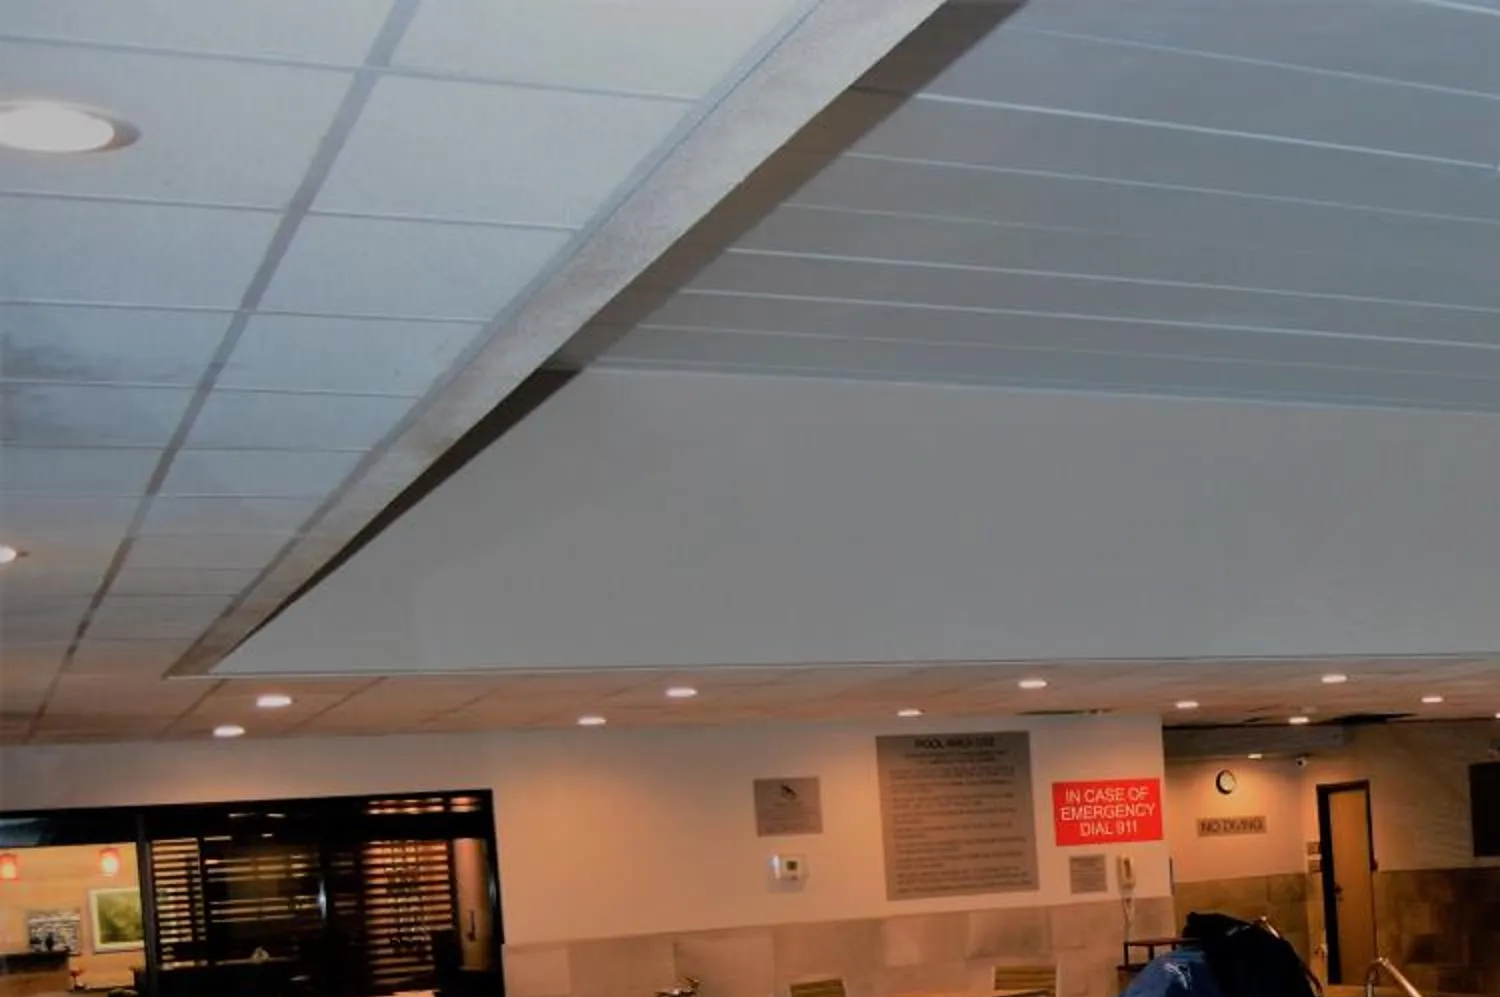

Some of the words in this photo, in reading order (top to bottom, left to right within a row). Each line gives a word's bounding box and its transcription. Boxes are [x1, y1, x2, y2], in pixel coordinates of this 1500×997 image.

[1065, 787, 1081, 804] IN
[1083, 786, 1126, 804] CASE
[1127, 784, 1150, 802] OF
[1060, 802, 1156, 822] EMERGENCY
[1080, 821, 1113, 837] DIAL
[1115, 819, 1138, 835] 911
[1200, 819, 1221, 833] NO
